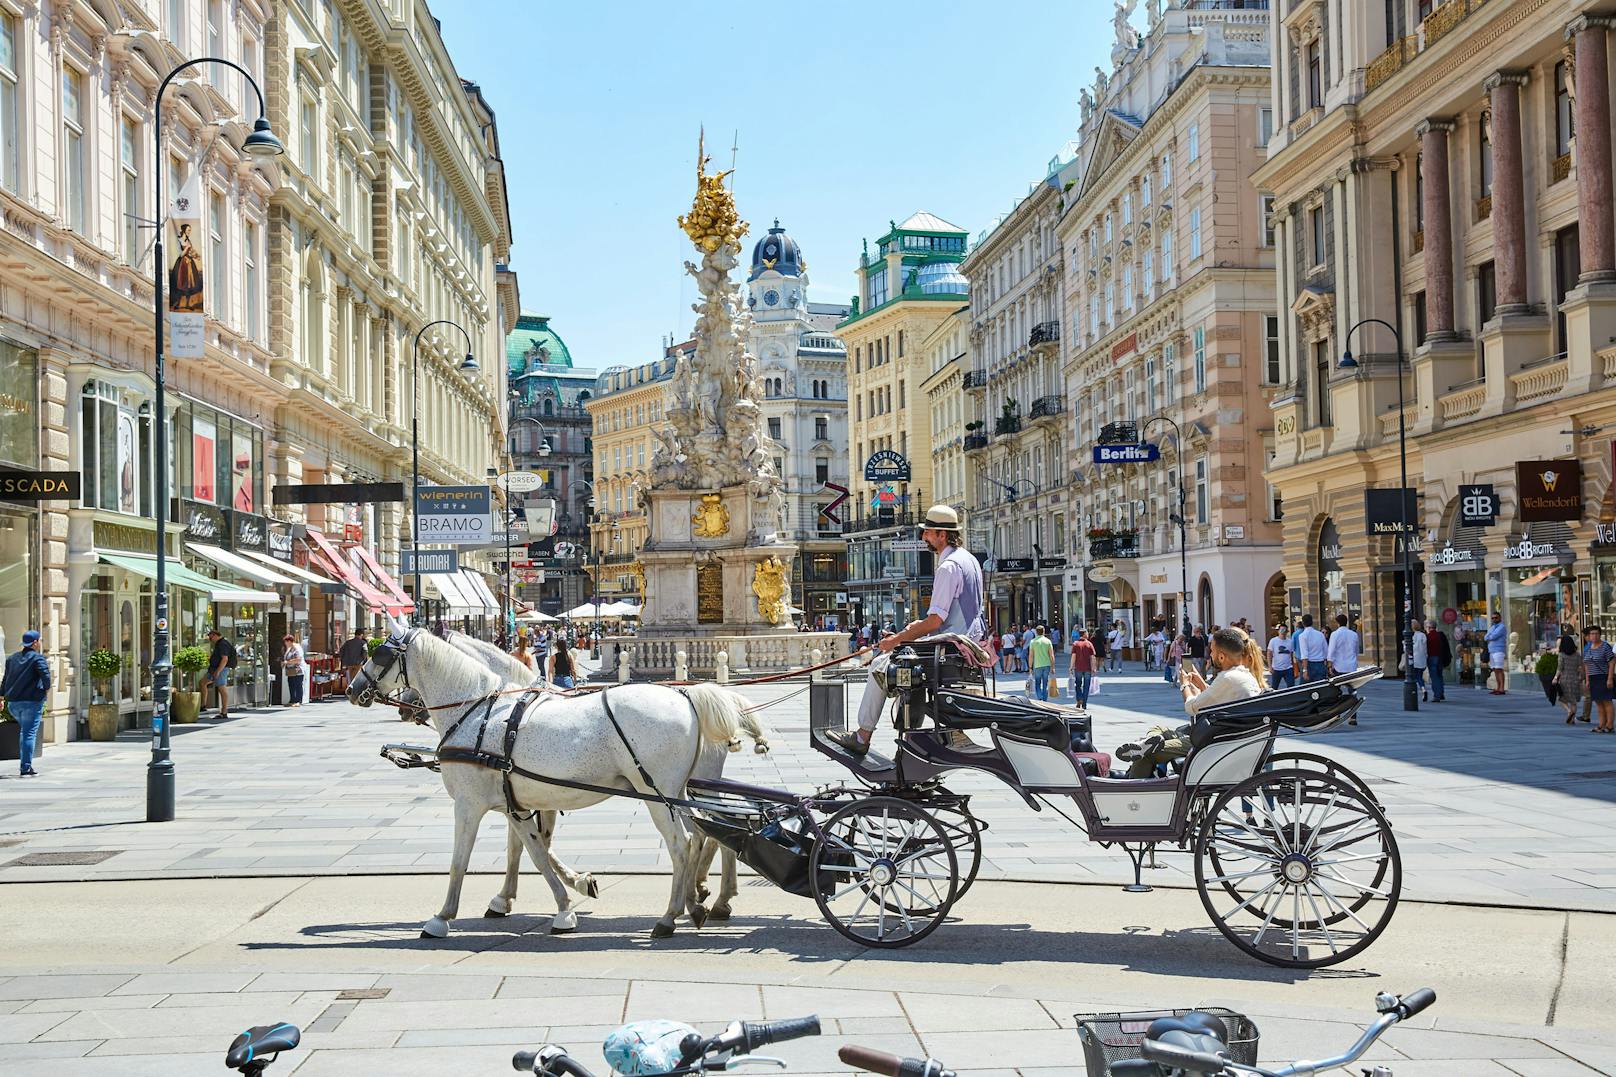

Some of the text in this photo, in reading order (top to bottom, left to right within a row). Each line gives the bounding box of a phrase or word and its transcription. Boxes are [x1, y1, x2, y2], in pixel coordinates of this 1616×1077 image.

[0, 479, 69, 492] SCADA
[420, 492, 483, 500] wienerin
[1522, 496, 1579, 508] Wellendorff
[420, 518, 483, 531] BRAMO
[1374, 522, 1414, 533] MaxMaa
[1596, 522, 1616, 544] Wel
[409, 554, 450, 571] BAUMAX
[1007, 560, 1021, 568] IWC
